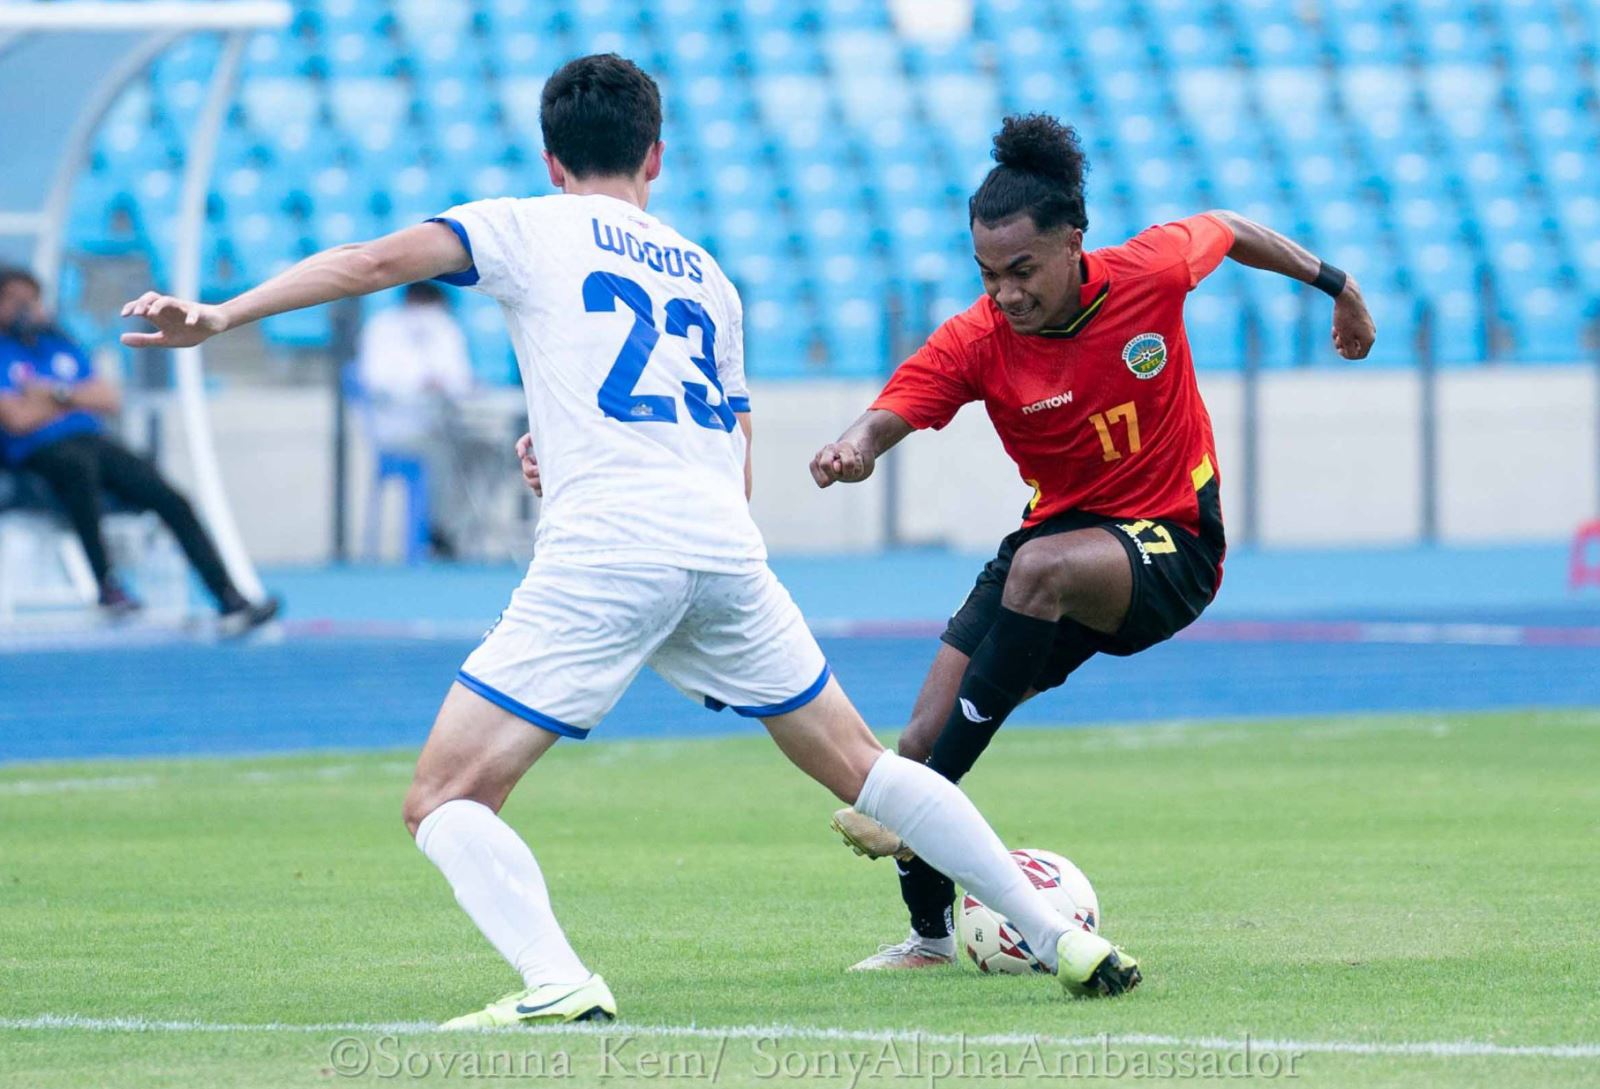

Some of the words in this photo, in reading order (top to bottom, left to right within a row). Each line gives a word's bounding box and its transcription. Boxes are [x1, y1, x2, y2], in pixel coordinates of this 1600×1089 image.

[592, 217, 703, 284] WOODS
[582, 270, 737, 433] 23
[1022, 390, 1073, 415] narrow
[1088, 401, 1142, 462] 17
